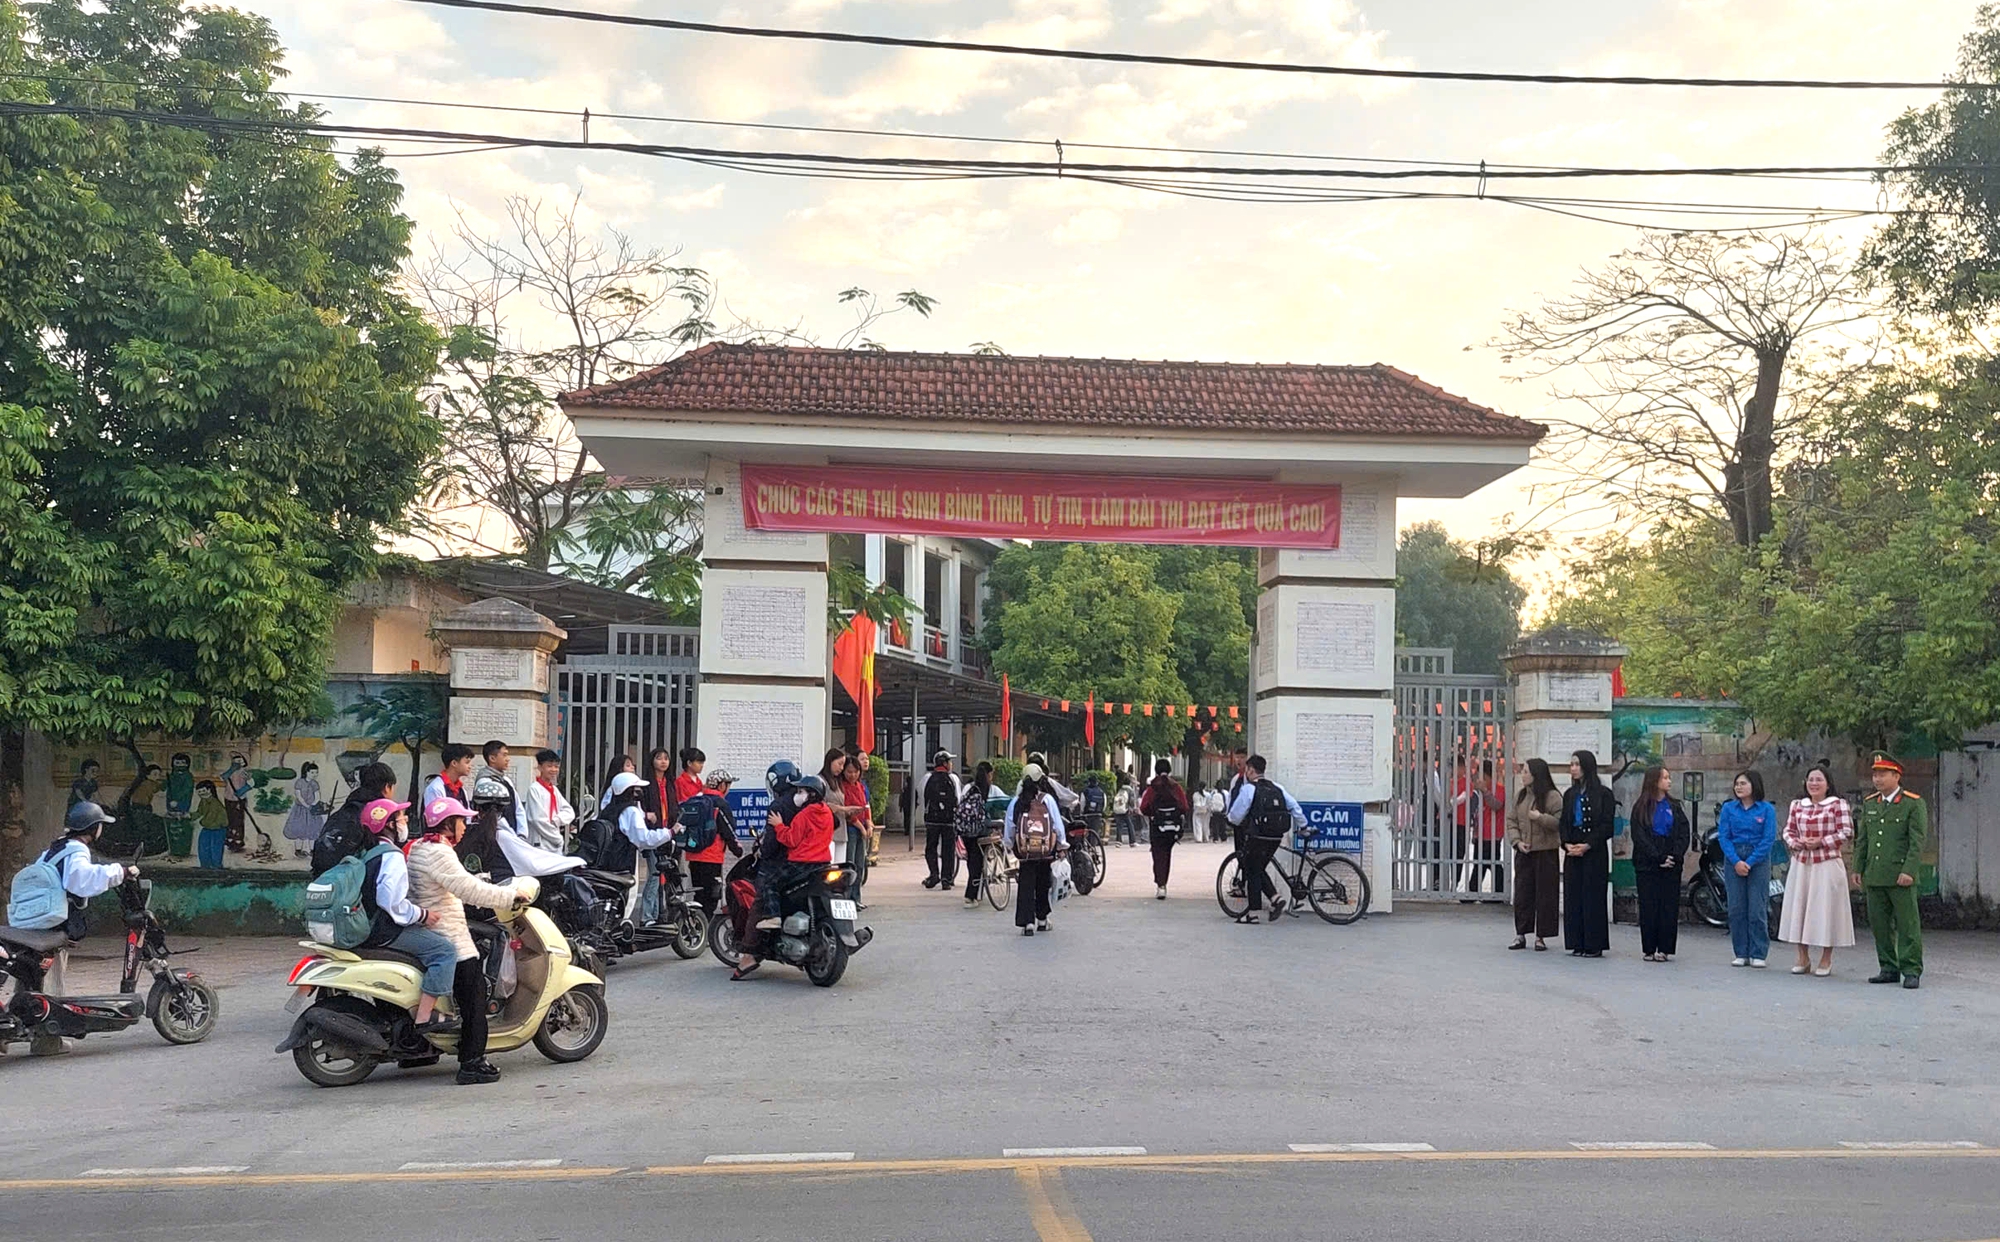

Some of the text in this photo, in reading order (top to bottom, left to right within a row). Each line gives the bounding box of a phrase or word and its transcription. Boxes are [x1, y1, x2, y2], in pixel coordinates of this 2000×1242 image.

[757, 479, 1325, 535] CHÚC CÁC EM THÍ SINH BÌNH TĨNH, TỰ TIN, LÀM BÀI THI ĐẠT KẾT QUẢ CAO!
[1310, 805, 1349, 823] CẤM
[1326, 827, 1338, 836] XE
[1340, 826, 1360, 837] MÁY
